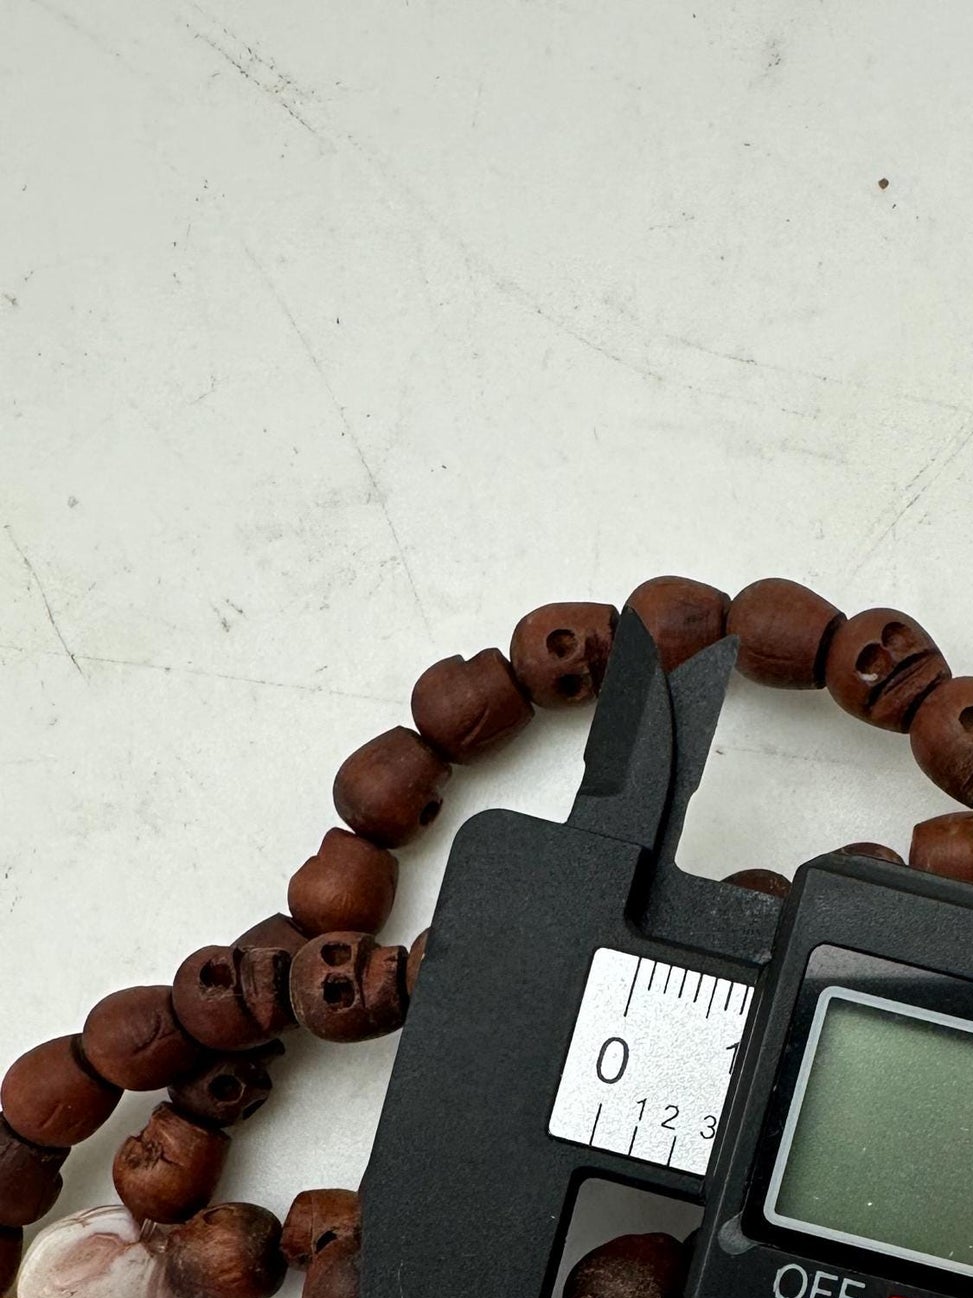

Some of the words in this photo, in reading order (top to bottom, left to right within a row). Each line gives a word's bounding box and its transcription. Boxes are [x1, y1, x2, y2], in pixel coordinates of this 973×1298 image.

[596, 1036, 630, 1084] 0
[636, 1097, 647, 1121] 1
[660, 1104, 680, 1130] 2
[699, 1114, 717, 1140] 3
